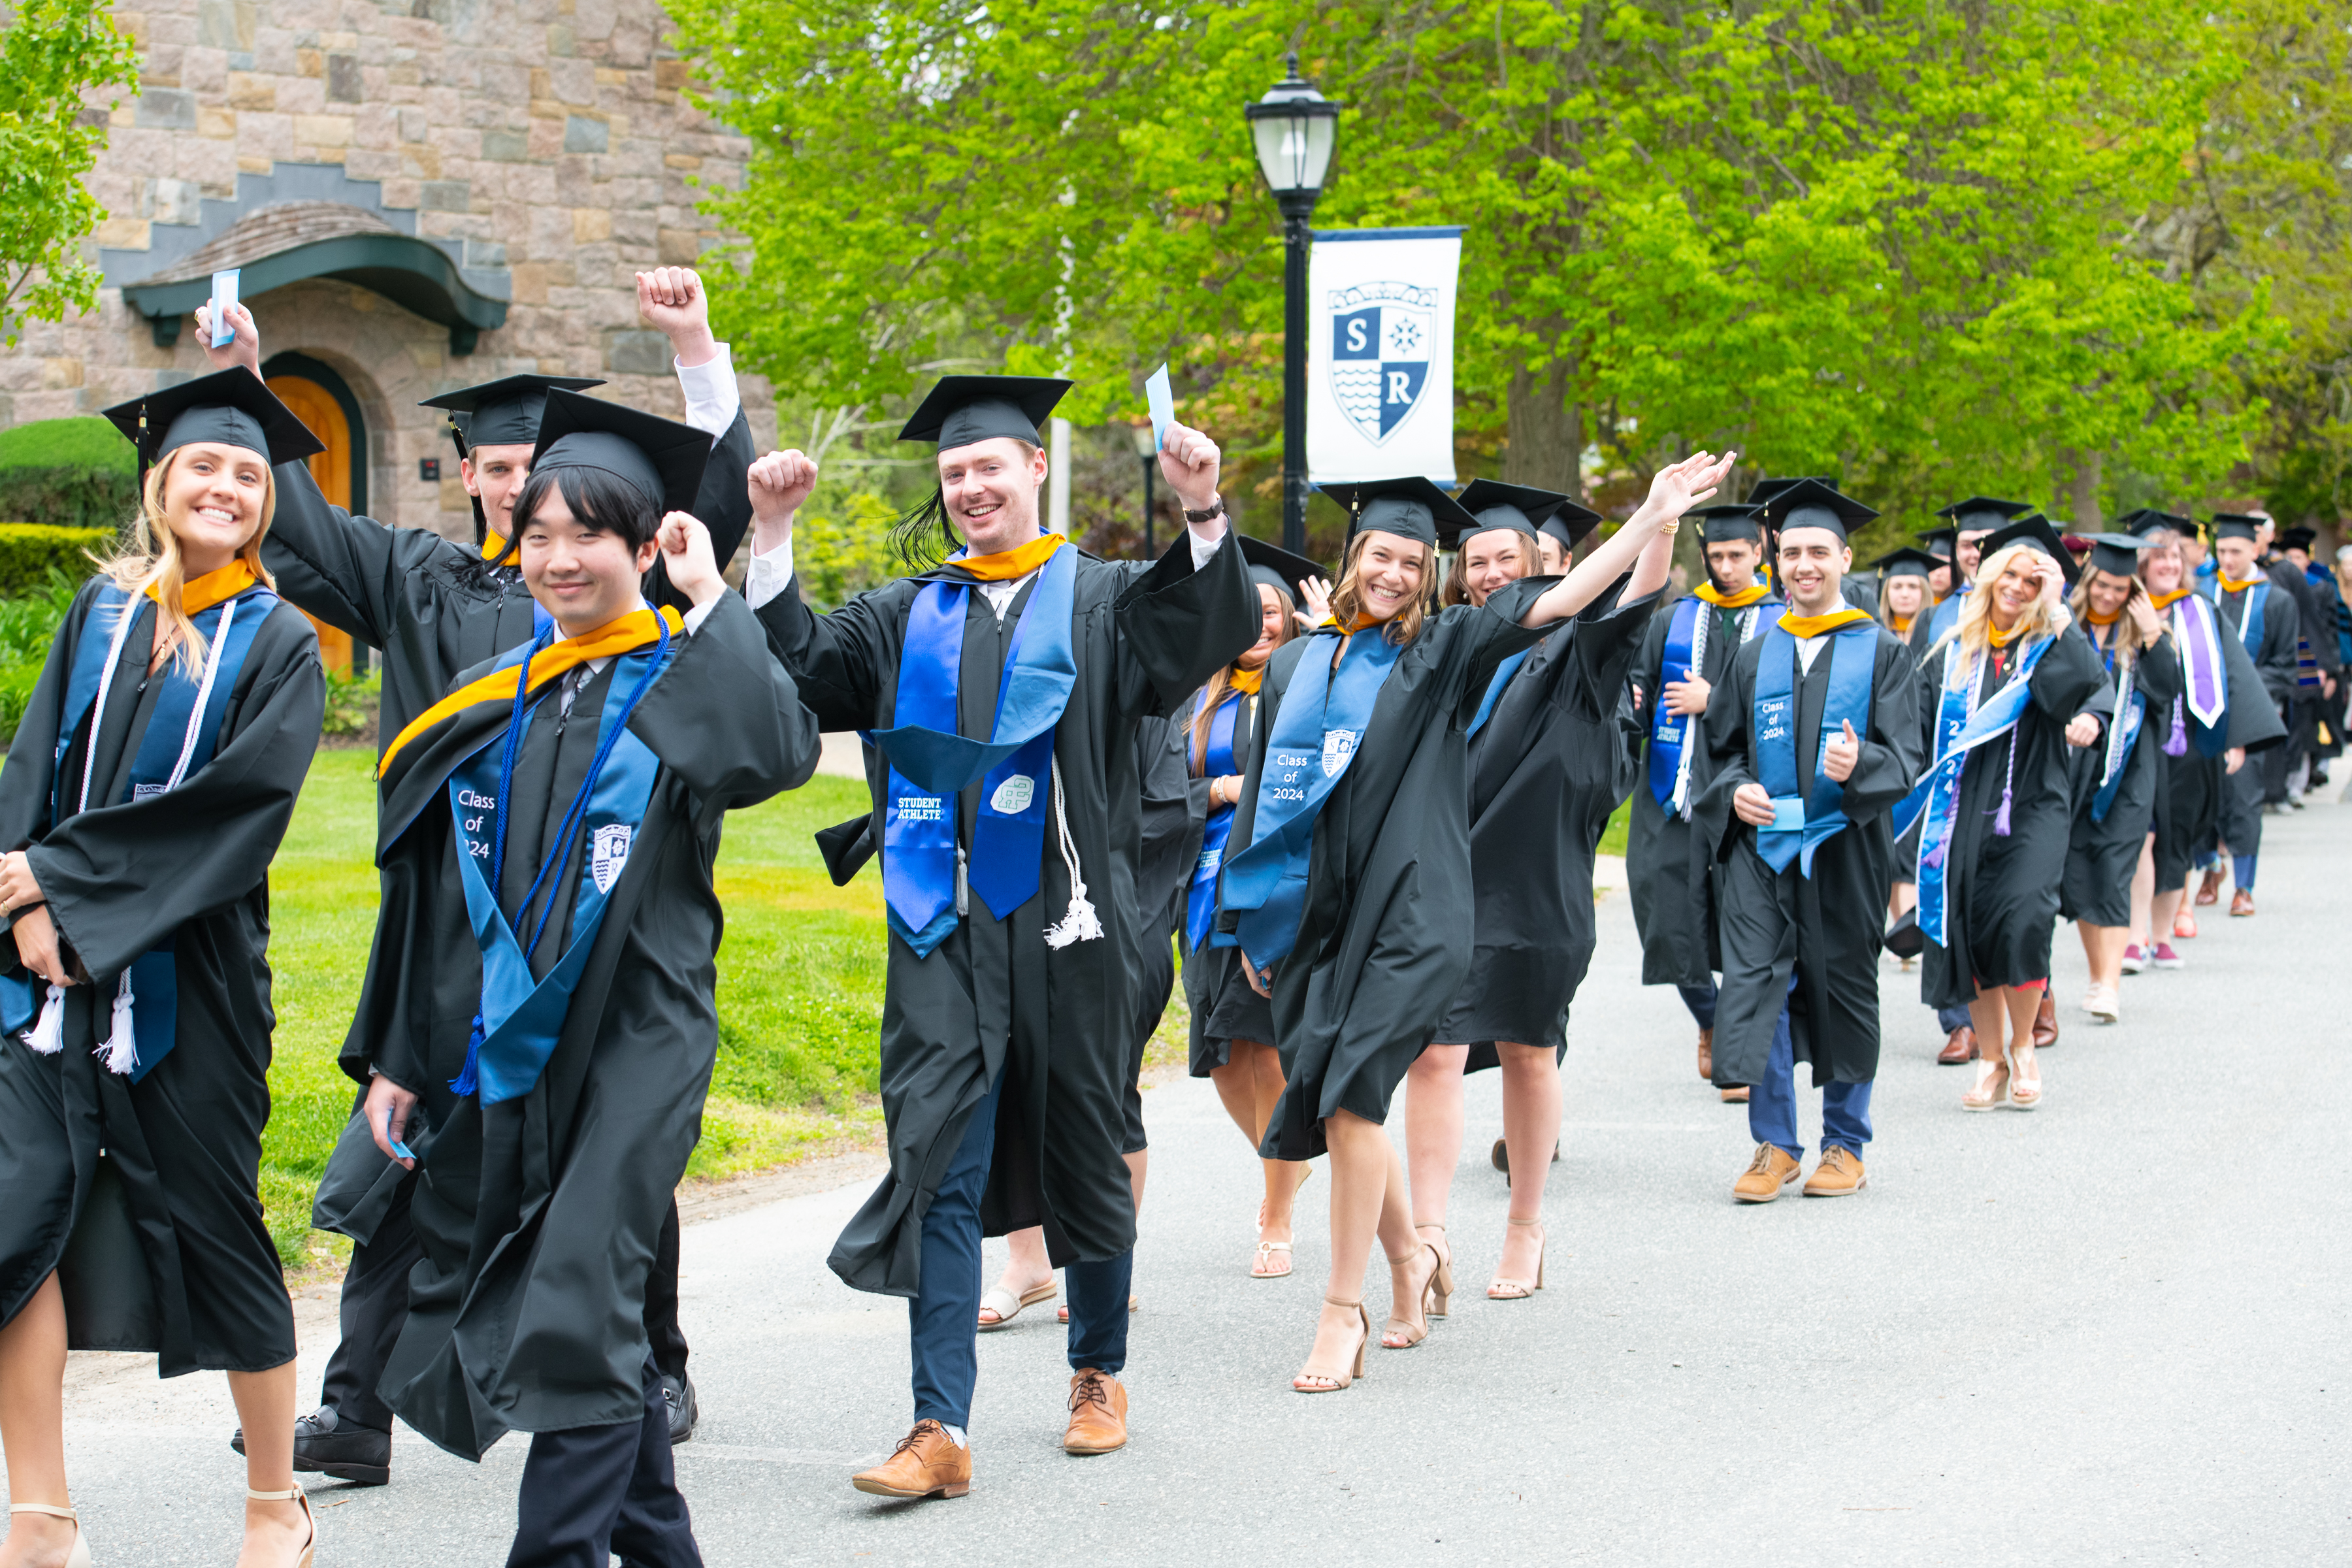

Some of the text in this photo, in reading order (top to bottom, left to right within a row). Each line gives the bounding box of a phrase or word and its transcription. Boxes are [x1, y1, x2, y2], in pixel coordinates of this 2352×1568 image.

[1347, 318, 1367, 352] S
[1386, 371, 1413, 404] R
[1761, 701, 1784, 713] Class
[1769, 713, 1779, 726] of
[1763, 726, 1785, 741] 2024
[1277, 753, 1307, 766] Class
[1283, 771, 1299, 783] of
[458, 789, 495, 809] Class
[1273, 787, 1305, 802] 2024
[898, 797, 941, 809] STUDENT
[897, 809, 941, 820] ATHLETE
[465, 815, 485, 832] of
[600, 841, 608, 855] S
[610, 862, 618, 875] R
